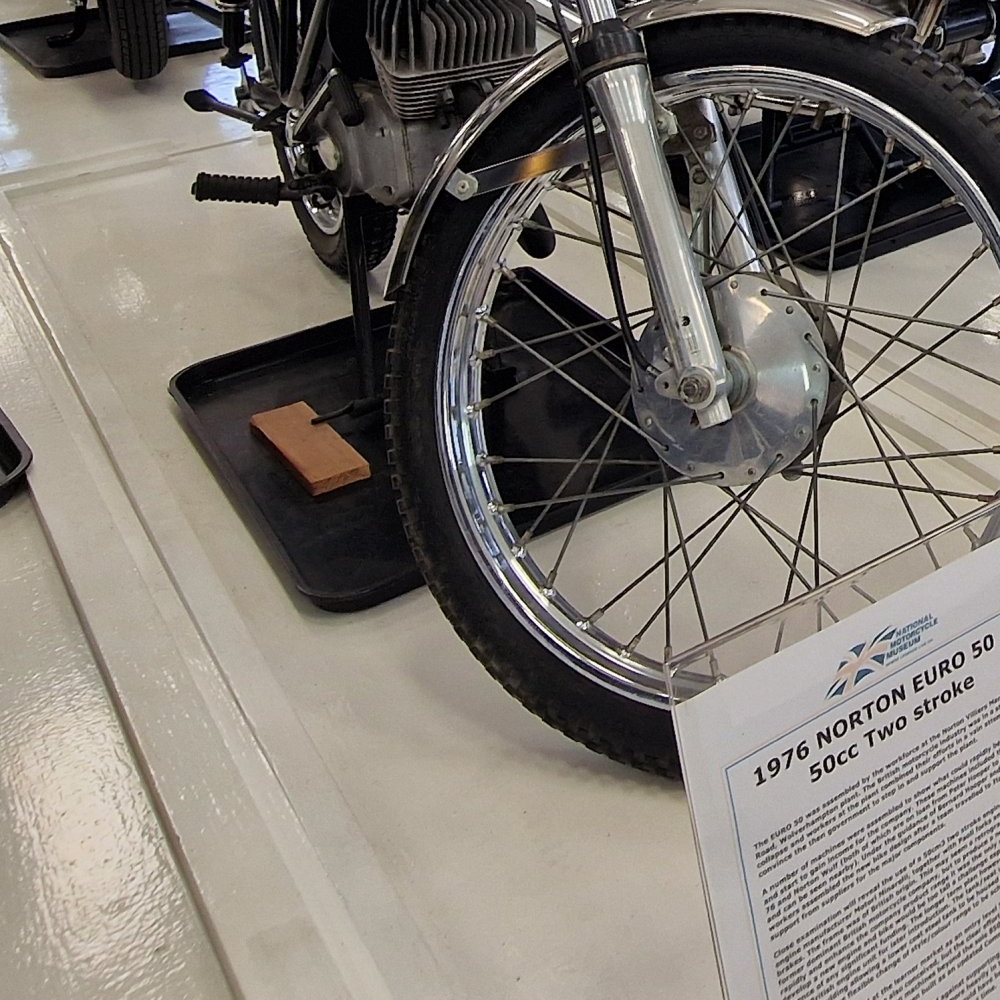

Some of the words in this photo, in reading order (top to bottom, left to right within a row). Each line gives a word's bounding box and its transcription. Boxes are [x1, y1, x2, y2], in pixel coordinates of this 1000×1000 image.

[886, 636, 921, 660] MUSEUM
[890, 618, 938, 649] MOTORCYCLE
[895, 613, 933, 637] NATIONAL
[753, 741, 810, 786] 1976
[816, 685, 907, 750] NORTON
[912, 651, 966, 693] EURO
[971, 634, 995, 659] 50
[808, 744, 860, 783] 50cc
[863, 716, 908, 749] Two
[913, 675, 976, 721] stroke
[754, 836, 768, 850] The
[770, 821, 791, 840] EURO
[805, 806, 820, 819] was
[821, 780, 860, 809] assembled
[872, 766, 883, 778] the
[885, 744, 919, 770] workforce
[929, 731, 940, 743] the
[941, 716, 964, 736] Norton
[756, 844, 788, 870] collapse
[790, 833, 804, 848] and
[806, 814, 836, 838] workers
[847, 800, 859, 812] the
[860, 787, 879, 806] plant
[880, 766, 913, 792] combined
[915, 755, 930, 770] their
[932, 741, 954, 759] efforts
[969, 723, 982, 737] vain
[757, 851, 792, 878] convince
[793, 842, 806, 855] the
[808, 830, 825, 846] then
[827, 802, 870, 836] government
[881, 786, 896, 802] step
[905, 772, 919, 785] and
[920, 755, 945, 778] support
[946, 747, 958, 759] the
[763, 890, 778, 905] and
[779, 877, 797, 894] start
[809, 859, 826, 877] gain
[827, 841, 853, 864] income
[855, 834, 865, 846] for
[867, 825, 879, 838] the
[915, 789, 935, 807] These
[936, 769, 967, 794] machines
[968, 751, 995, 773] included
[769, 867, 798, 891] number
[810, 837, 845, 865] machines
[847, 827, 864, 842] were
[866, 801, 903, 830] assembled
[913, 783, 931, 800] show
[932, 771, 949, 787] what
[950, 759, 968, 776] could
[969, 745, 991, 766] rapidly
[777, 891, 791, 906] and
[793, 874, 819, 896] Norton
[840, 848, 860, 867] (both
[870, 827, 891, 846] which
[892, 820, 904, 832] are
[915, 802, 930, 817] loan
[931, 791, 947, 807] from
[948, 779, 965, 795] Peter
[779, 803, 838, 846] Wolverhampton
[863, 780, 875, 793] The
[877, 765, 899, 784] British
[901, 741, 938, 771] motorcycle
[939, 724, 966, 747] industry
[968, 717, 980, 728] was
[774, 944, 801, 969] engine
[802, 910, 852, 949] manufacturer
[911, 851, 940, 877] together
[942, 840, 956, 855] with
[975, 816, 991, 833] forks
[847, 973, 873, 998] flexible
[875, 954, 901, 979] change
[952, 905, 971, 924] range
